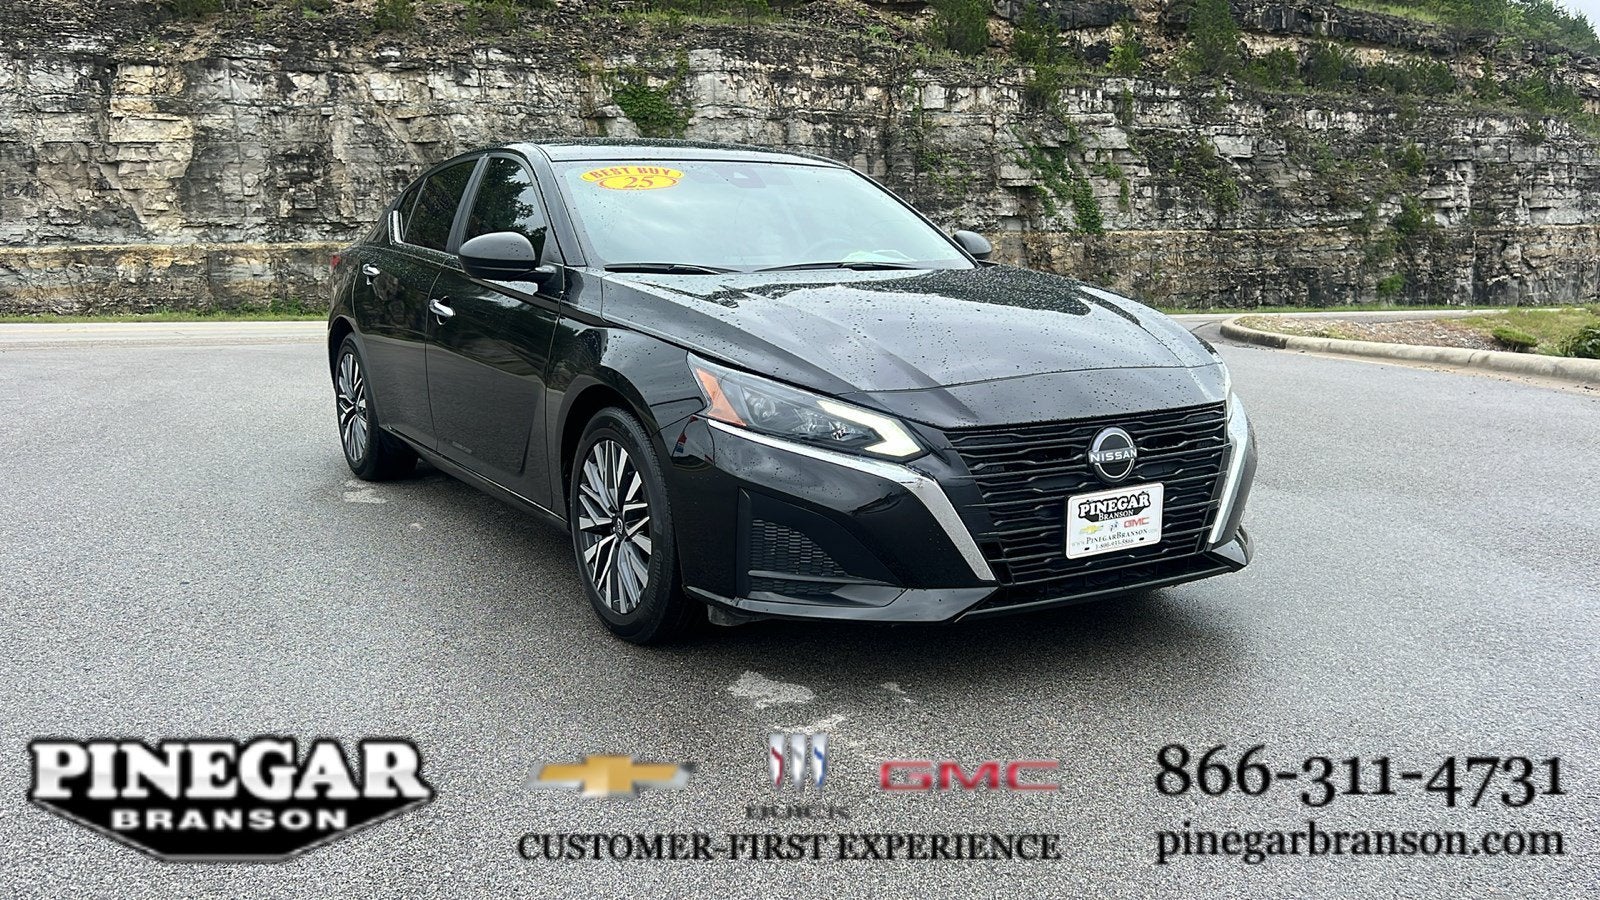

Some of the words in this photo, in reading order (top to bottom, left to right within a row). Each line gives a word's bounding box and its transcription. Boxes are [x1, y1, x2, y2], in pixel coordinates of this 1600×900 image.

[589, 167, 630, 178] BEST
[637, 167, 670, 175] BUY
[623, 176, 653, 188] 25
[1091, 449, 1137, 462] NISSAN
[1079, 493, 1150, 517] PINEGAR
[1098, 510, 1134, 521] BRANSON
[1123, 517, 1149, 528] GMC
